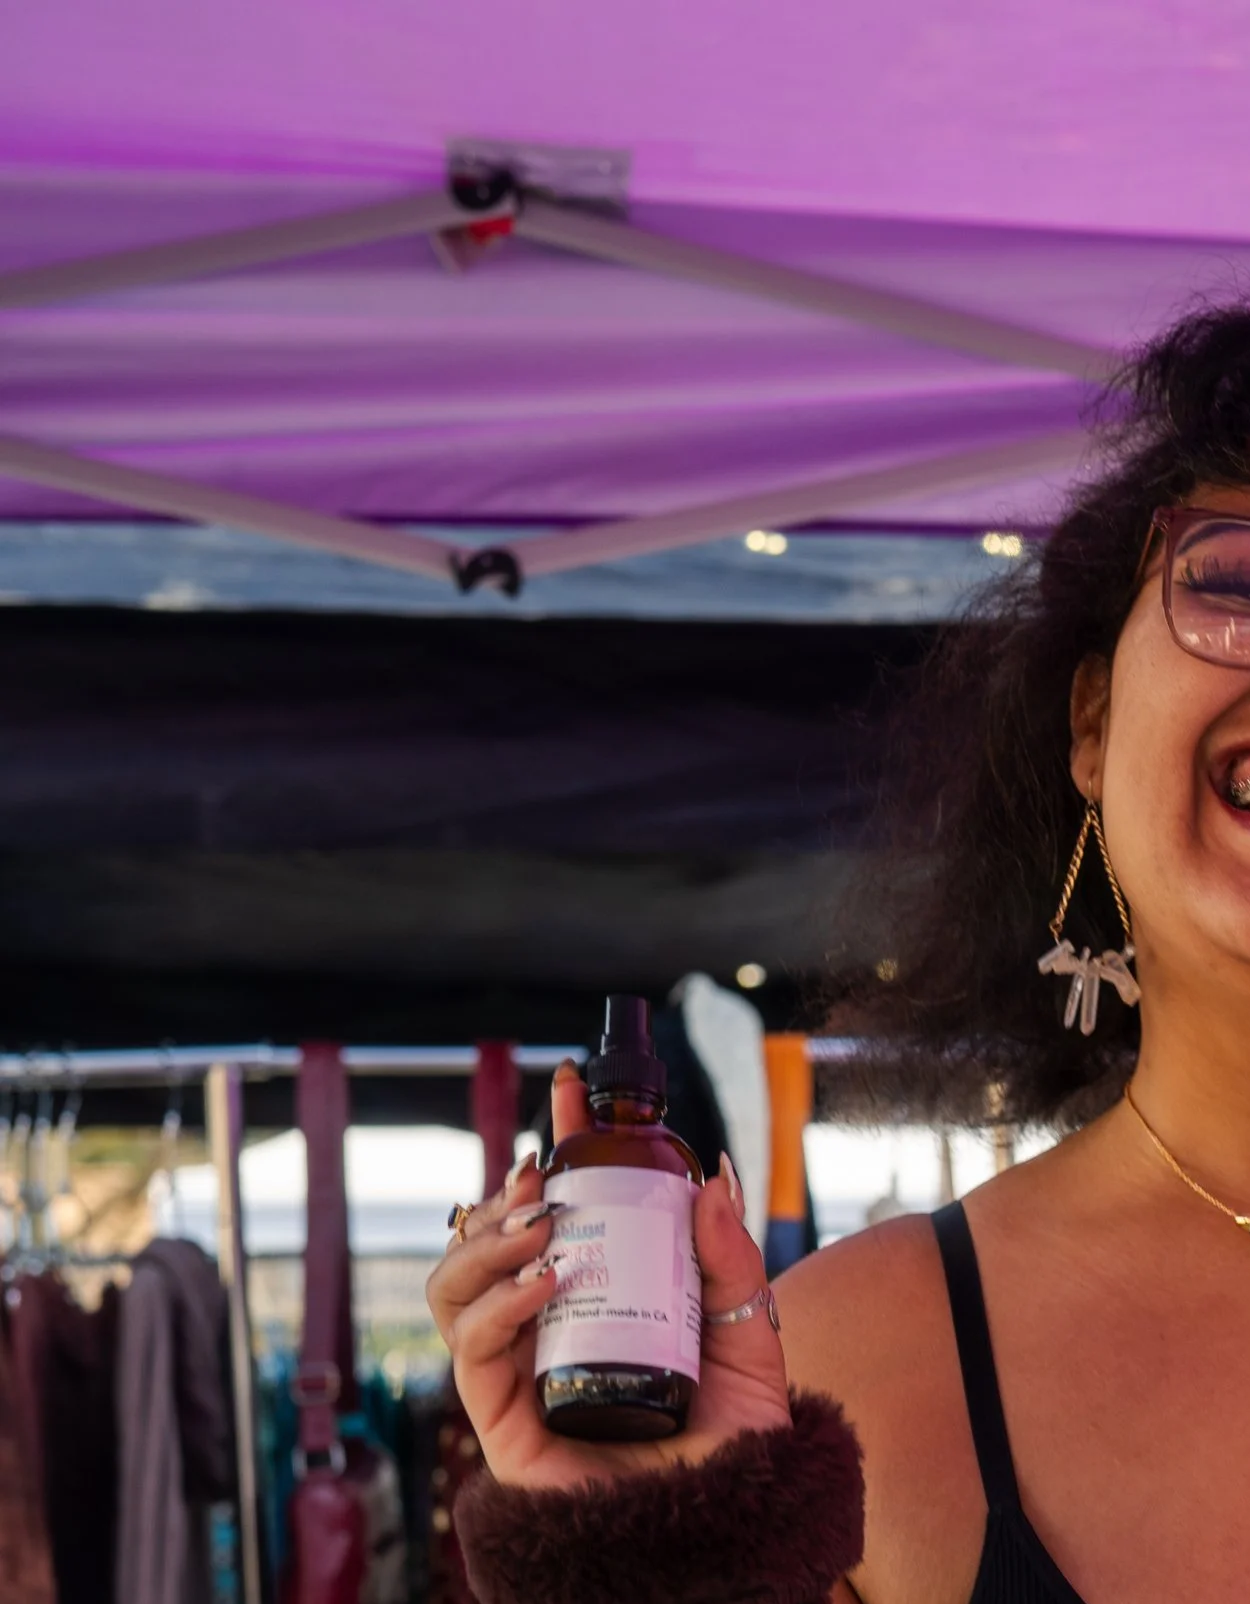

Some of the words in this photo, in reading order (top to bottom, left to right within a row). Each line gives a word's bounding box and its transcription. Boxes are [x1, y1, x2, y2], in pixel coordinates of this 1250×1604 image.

[572, 1305, 639, 1320] Hand-made
[641, 1306, 652, 1320] in
[653, 1308, 670, 1324] CA
